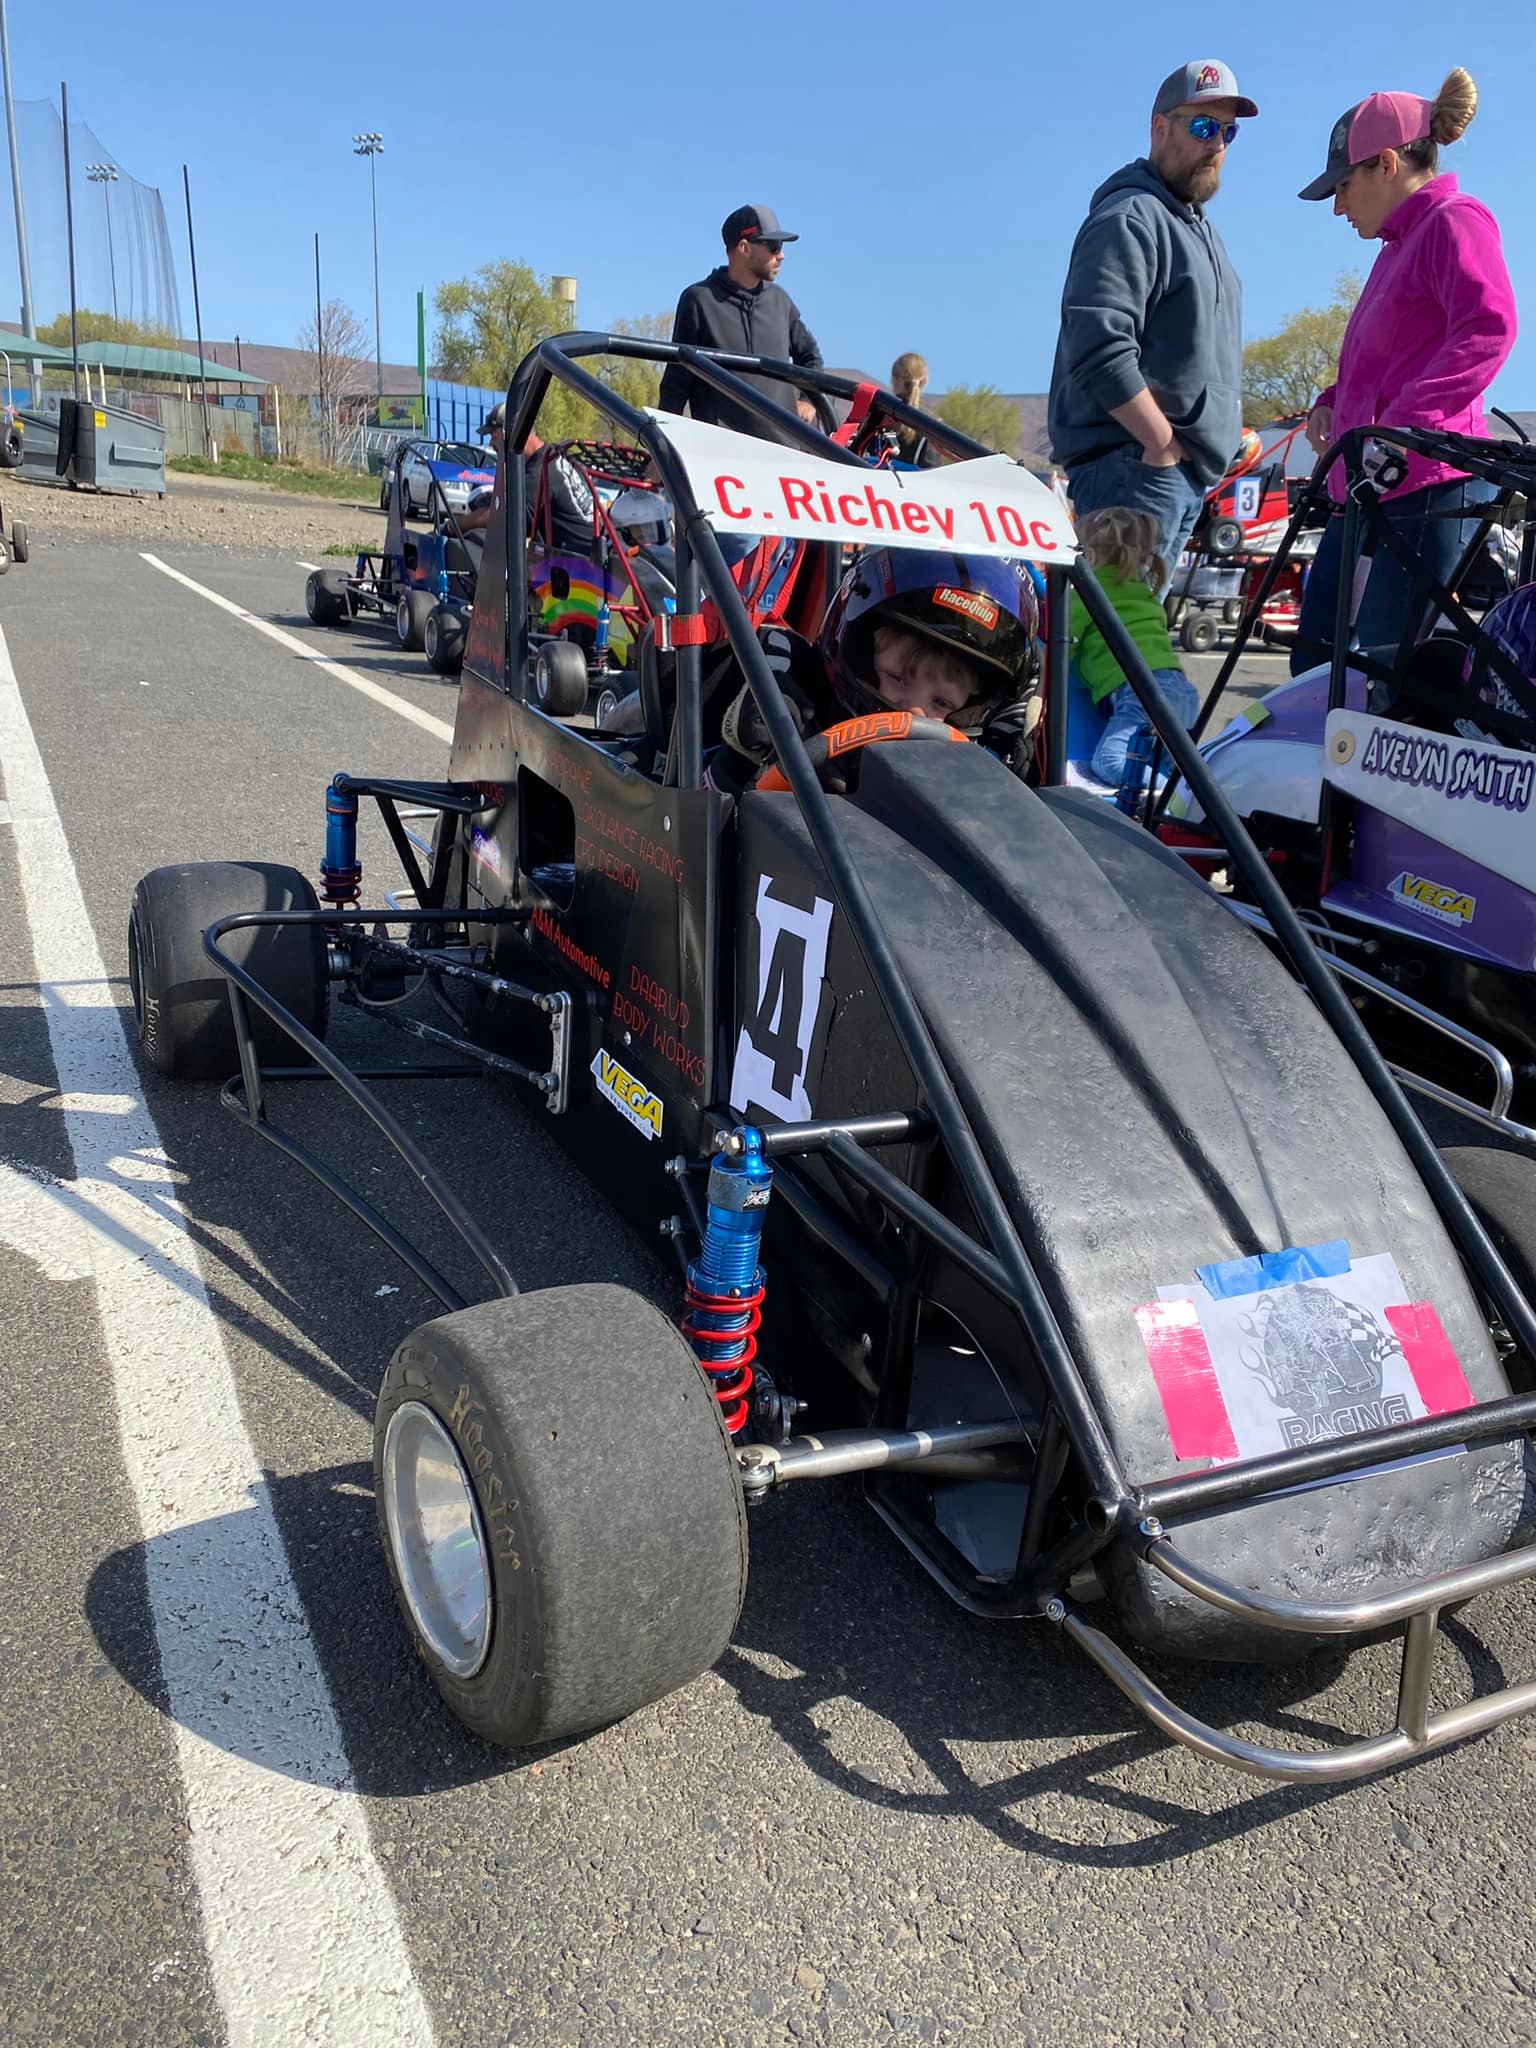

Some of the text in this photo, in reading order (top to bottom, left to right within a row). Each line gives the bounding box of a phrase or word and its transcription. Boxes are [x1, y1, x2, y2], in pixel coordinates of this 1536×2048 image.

[714, 475, 1057, 551] C. Richey 10c
[1241, 486, 1256, 512] 3
[939, 588, 994, 624] RaceQuip
[1362, 729, 1534, 810] AVELYN SMITH
[599, 848, 640, 894] DESIGN
[1402, 873, 1473, 921] VEGA
[553, 926, 610, 989] Automotive
[630, 965, 690, 1029] DAARUD
[613, 991, 706, 1086] BODY WORKS
[602, 1052, 662, 1133] VEGA
[1281, 1395, 1406, 1449] RACING
